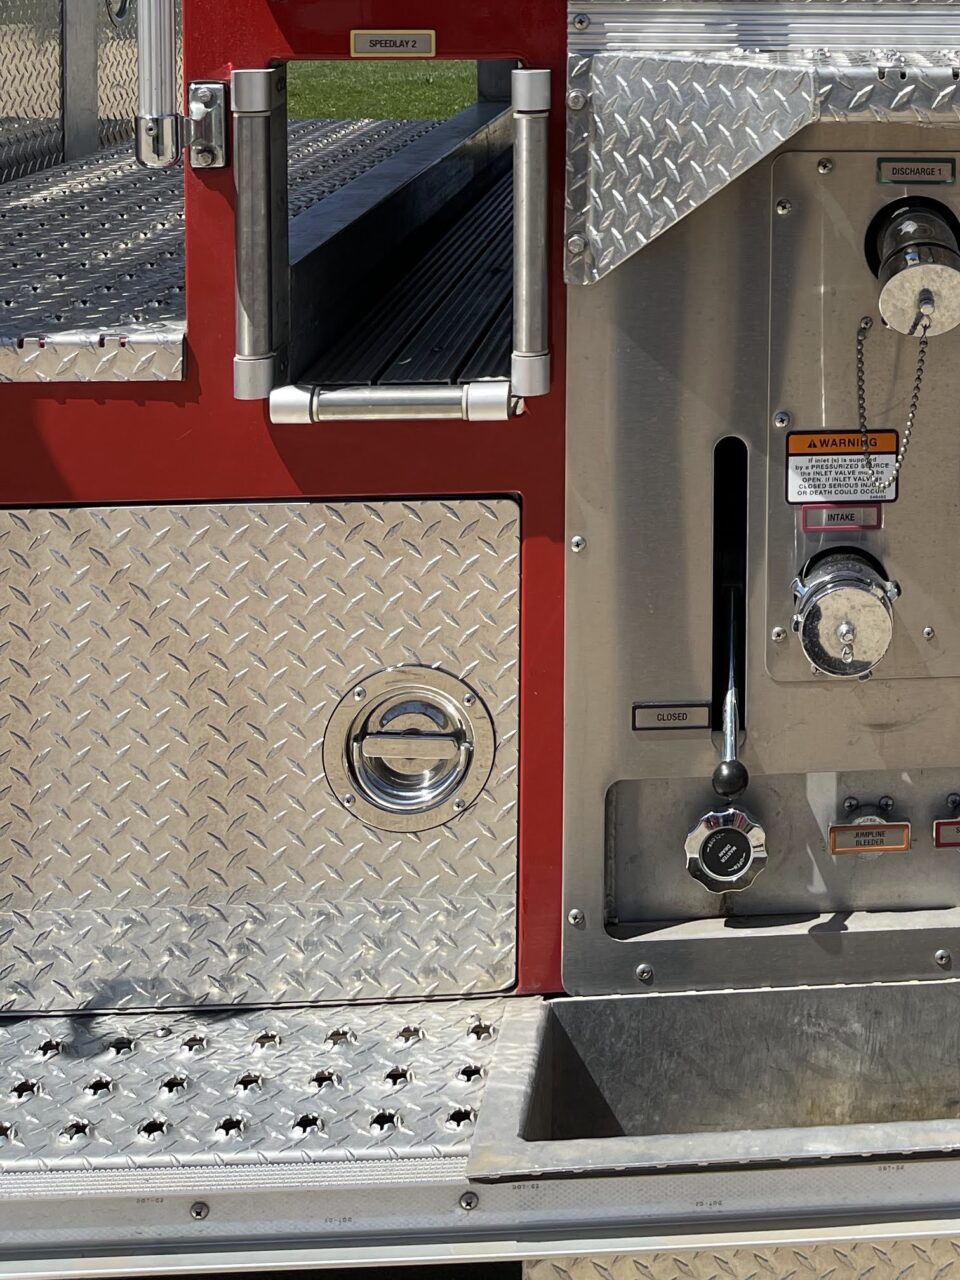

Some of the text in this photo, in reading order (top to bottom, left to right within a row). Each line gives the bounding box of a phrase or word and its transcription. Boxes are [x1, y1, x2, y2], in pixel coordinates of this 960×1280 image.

[368, 39, 417, 49] SPEEDLAY 2
[891, 166, 942, 176] DISCHARGE 1
[827, 513, 856, 521] INTAKE
[656, 712, 688, 721] CLOSED
[854, 830, 887, 839] JUMPLINE
[855, 838, 885, 847] BLEEDER
